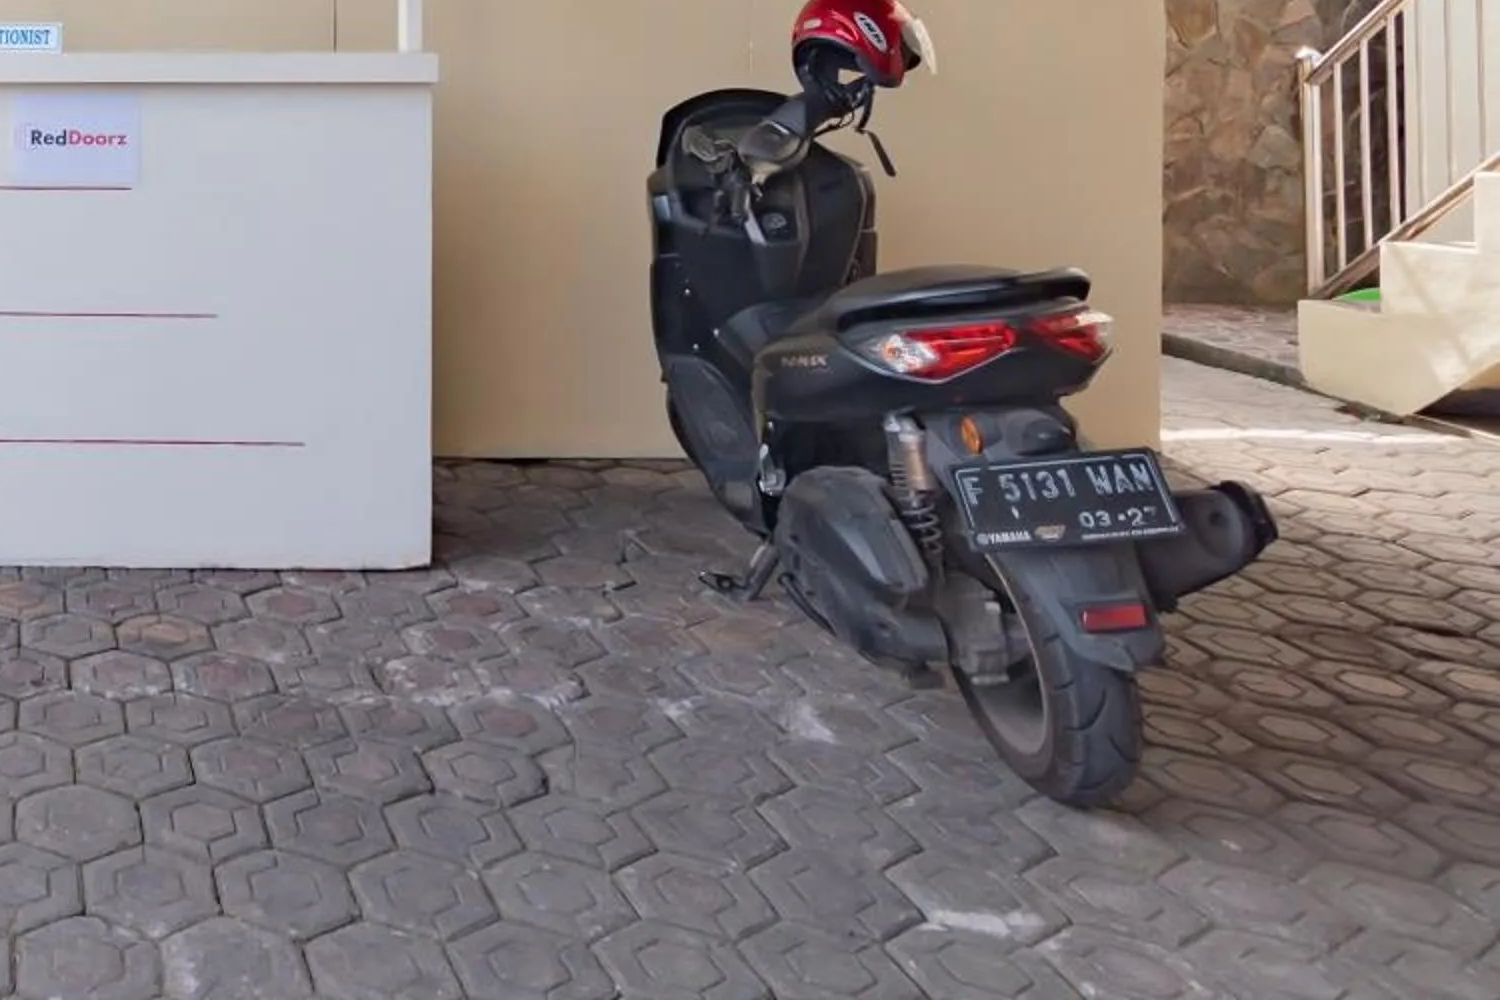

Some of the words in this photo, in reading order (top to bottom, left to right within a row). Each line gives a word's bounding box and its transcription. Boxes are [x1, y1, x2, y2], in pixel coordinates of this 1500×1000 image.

[30, 129, 128, 146] RedDoorz
[962, 477, 982, 505] F
[999, 469, 1077, 502] 5131
[1084, 462, 1154, 496] WAN
